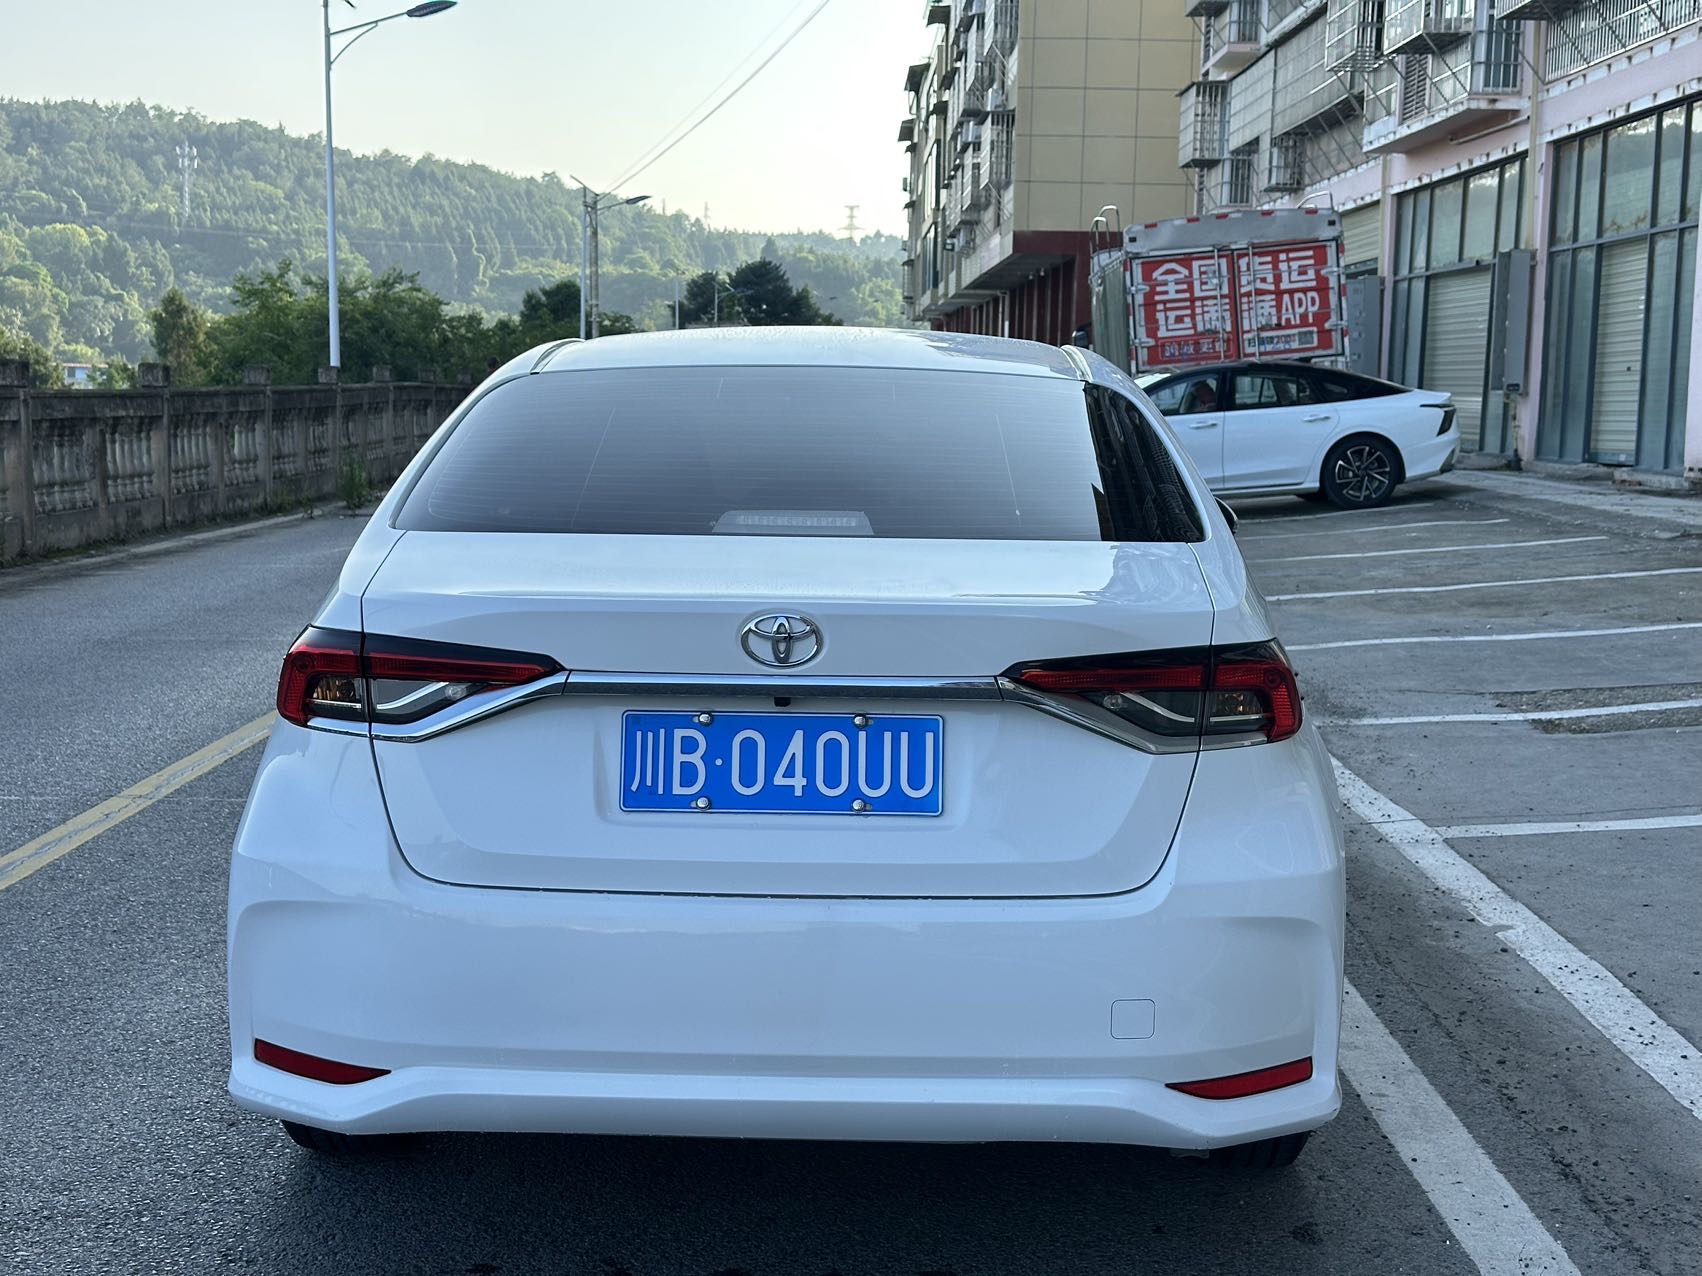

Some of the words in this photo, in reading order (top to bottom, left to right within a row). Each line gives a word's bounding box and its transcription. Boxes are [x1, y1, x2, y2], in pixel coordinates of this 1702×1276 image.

[1152, 250, 1316, 301] 全国货运
[1156, 291, 1320, 337] 运满满APP
